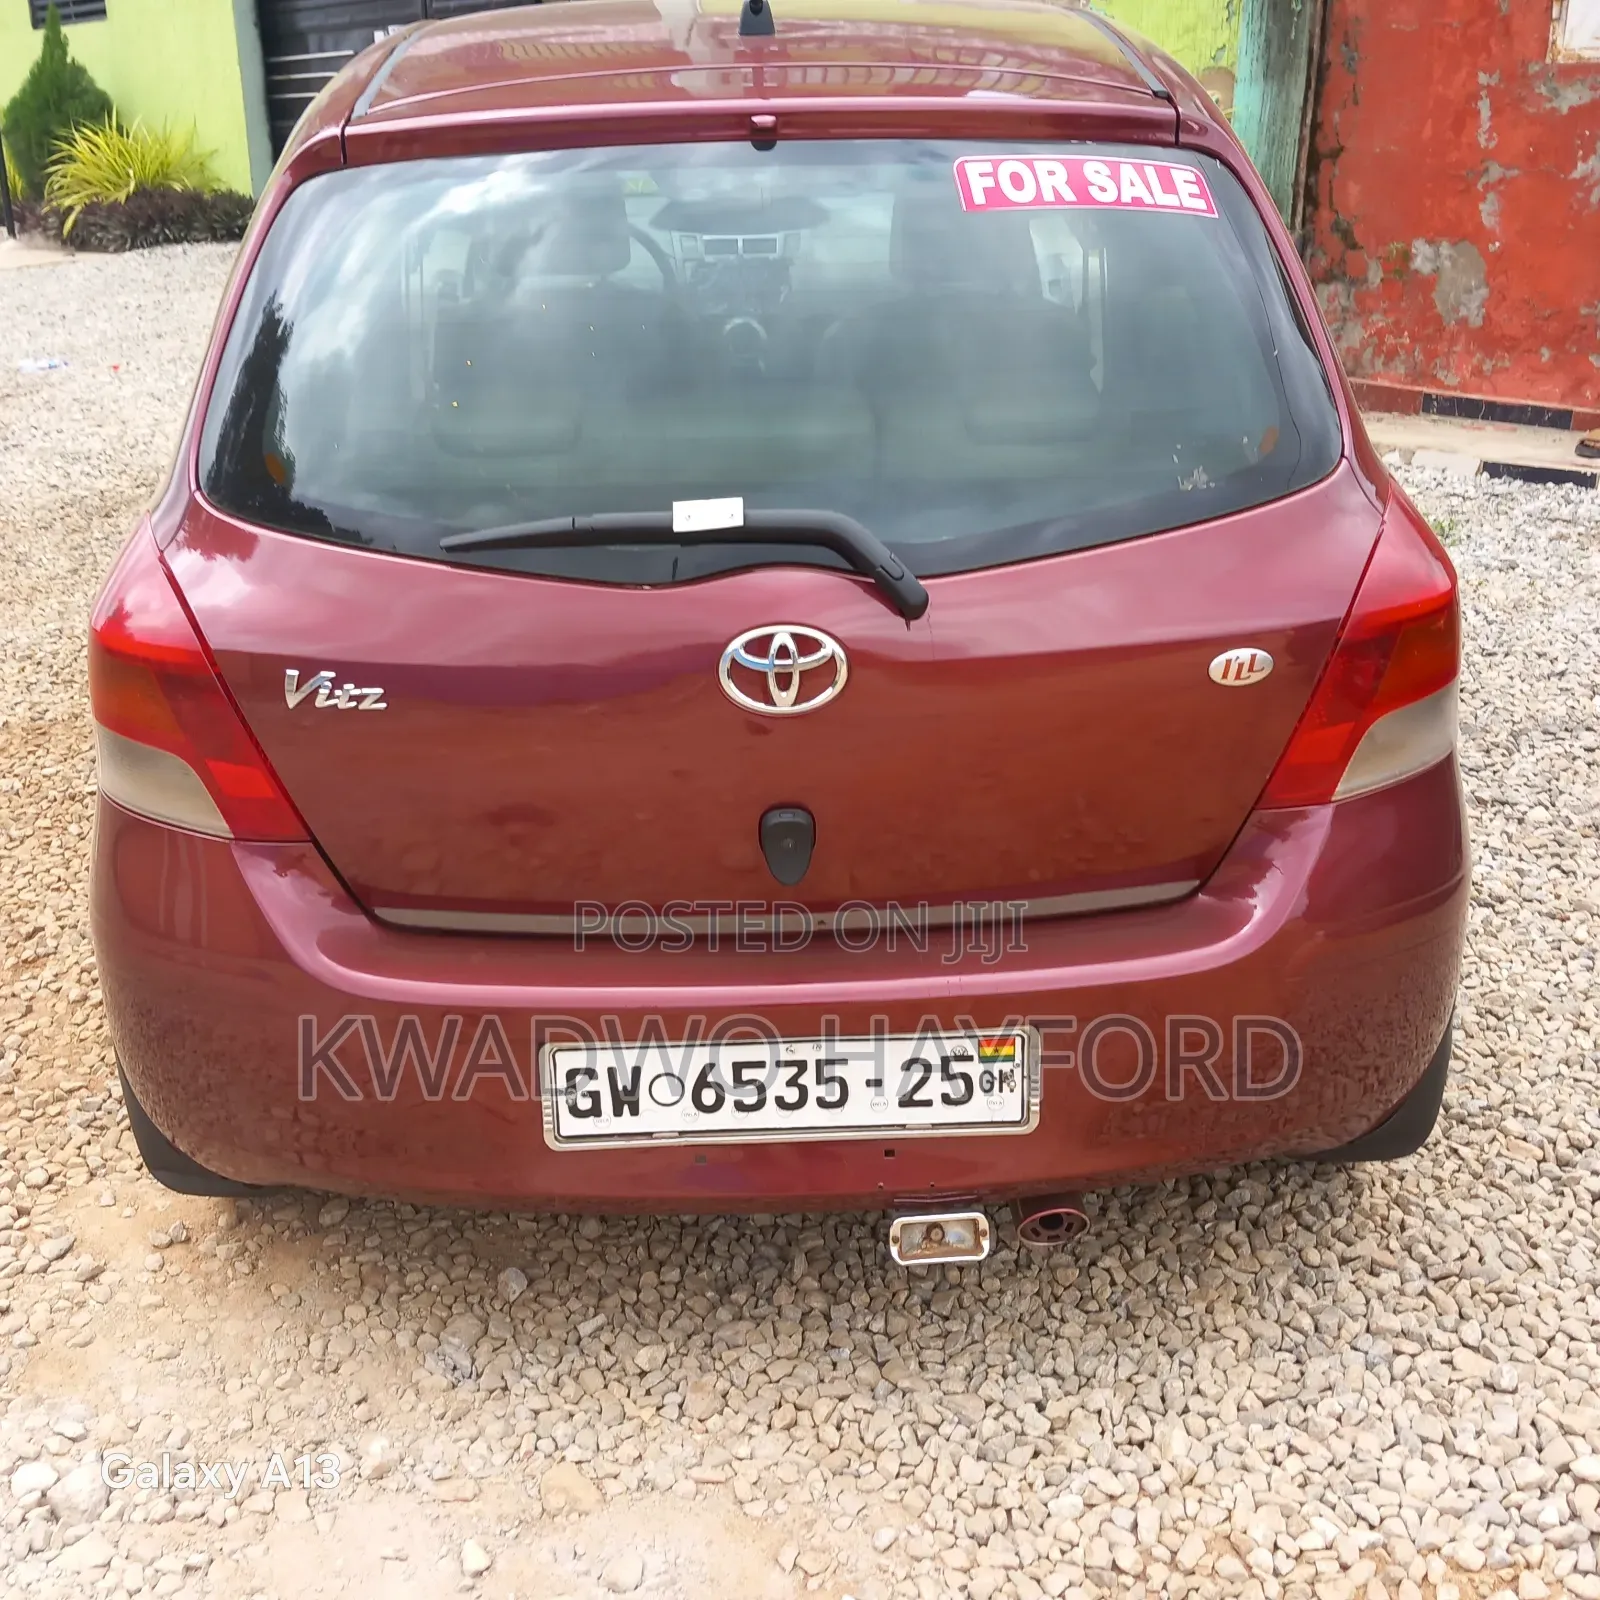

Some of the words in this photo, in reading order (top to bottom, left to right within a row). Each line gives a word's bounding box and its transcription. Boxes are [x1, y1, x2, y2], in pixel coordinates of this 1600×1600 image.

[964, 159, 1078, 205] FOR
[1082, 160, 1208, 211] SALE
[284, 668, 388, 711] Vitz
[565, 1065, 642, 1119] GW
